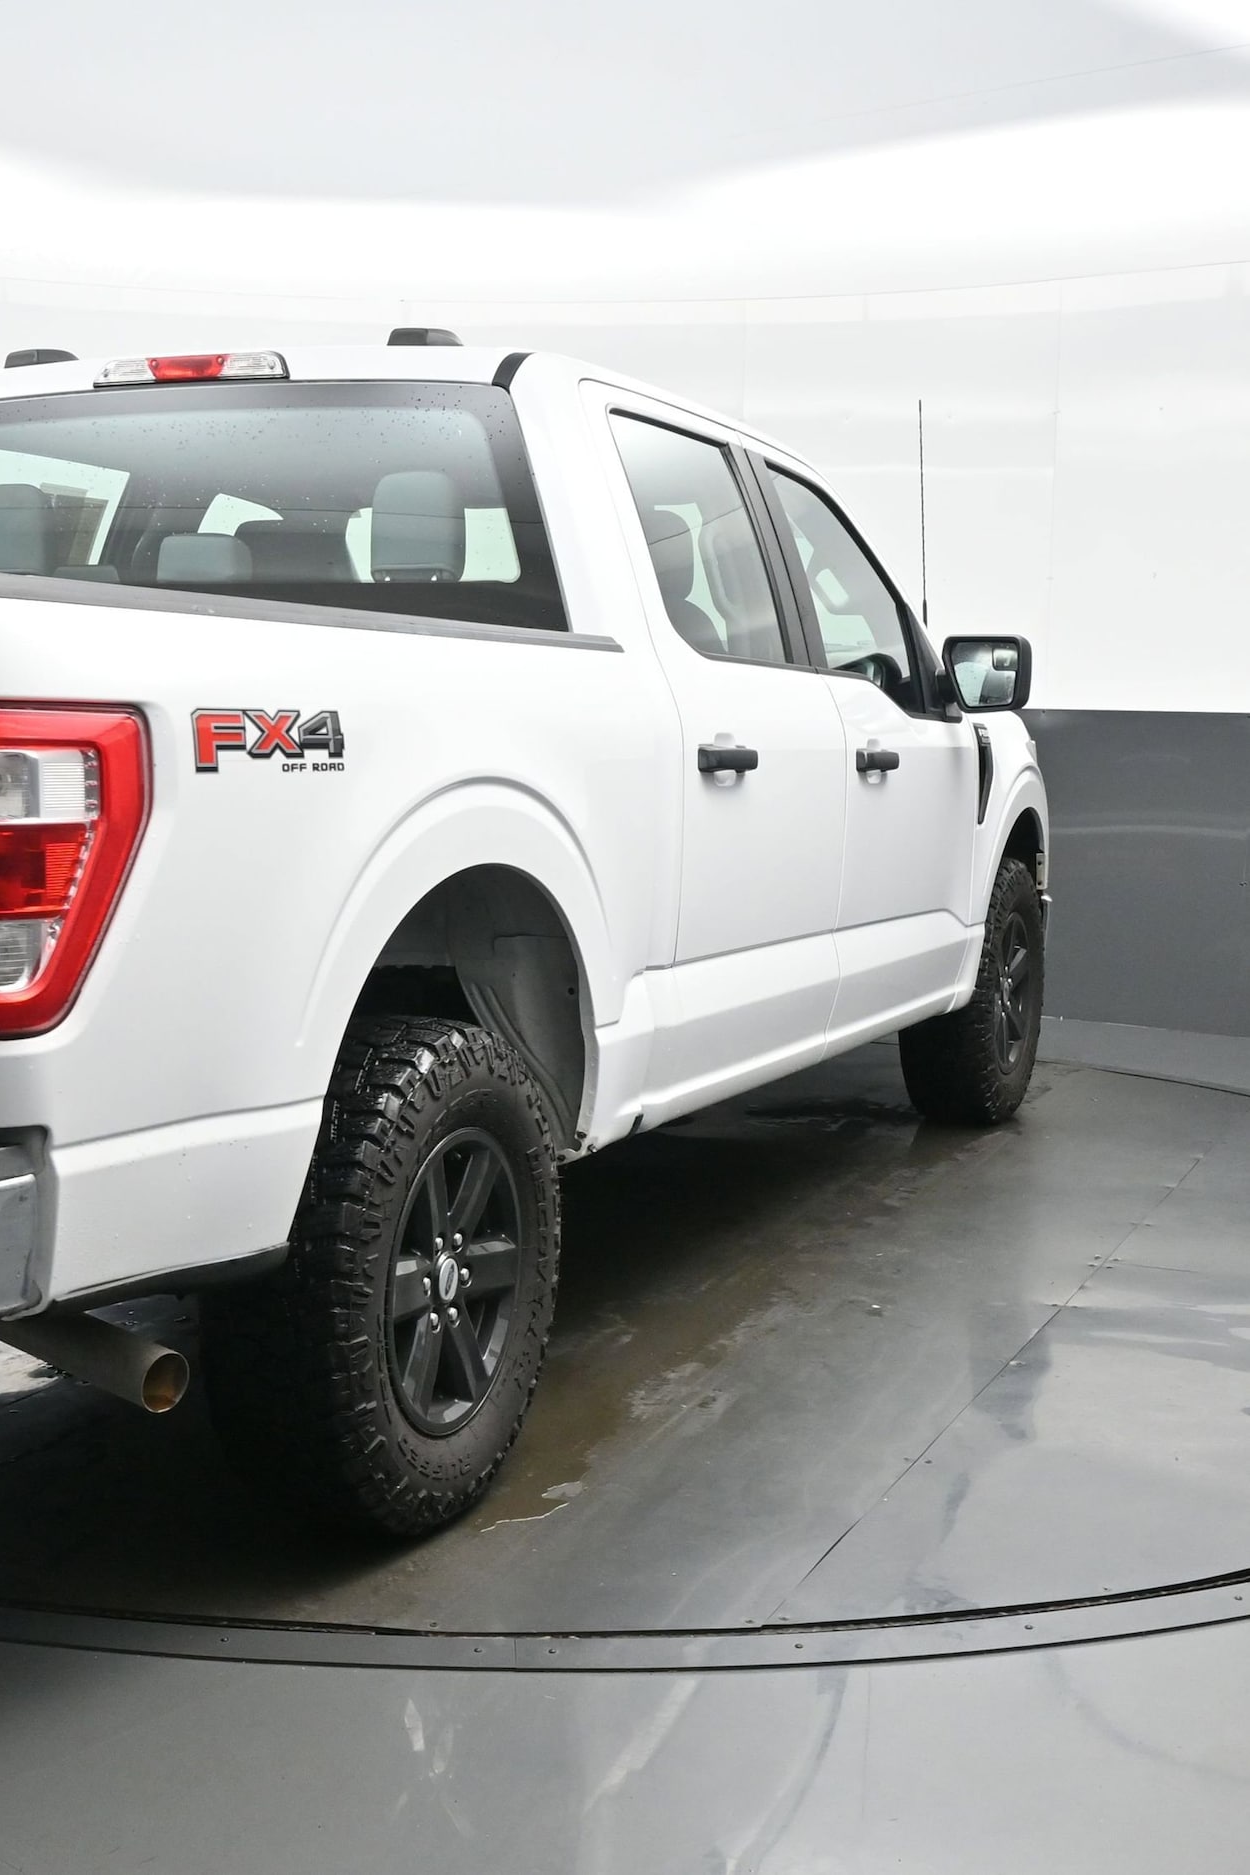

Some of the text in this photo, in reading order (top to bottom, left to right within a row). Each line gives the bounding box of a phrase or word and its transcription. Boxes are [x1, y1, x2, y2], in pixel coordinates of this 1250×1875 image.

[190, 708, 346, 774] FX4
[281, 762, 345, 773] OFF ROAD
